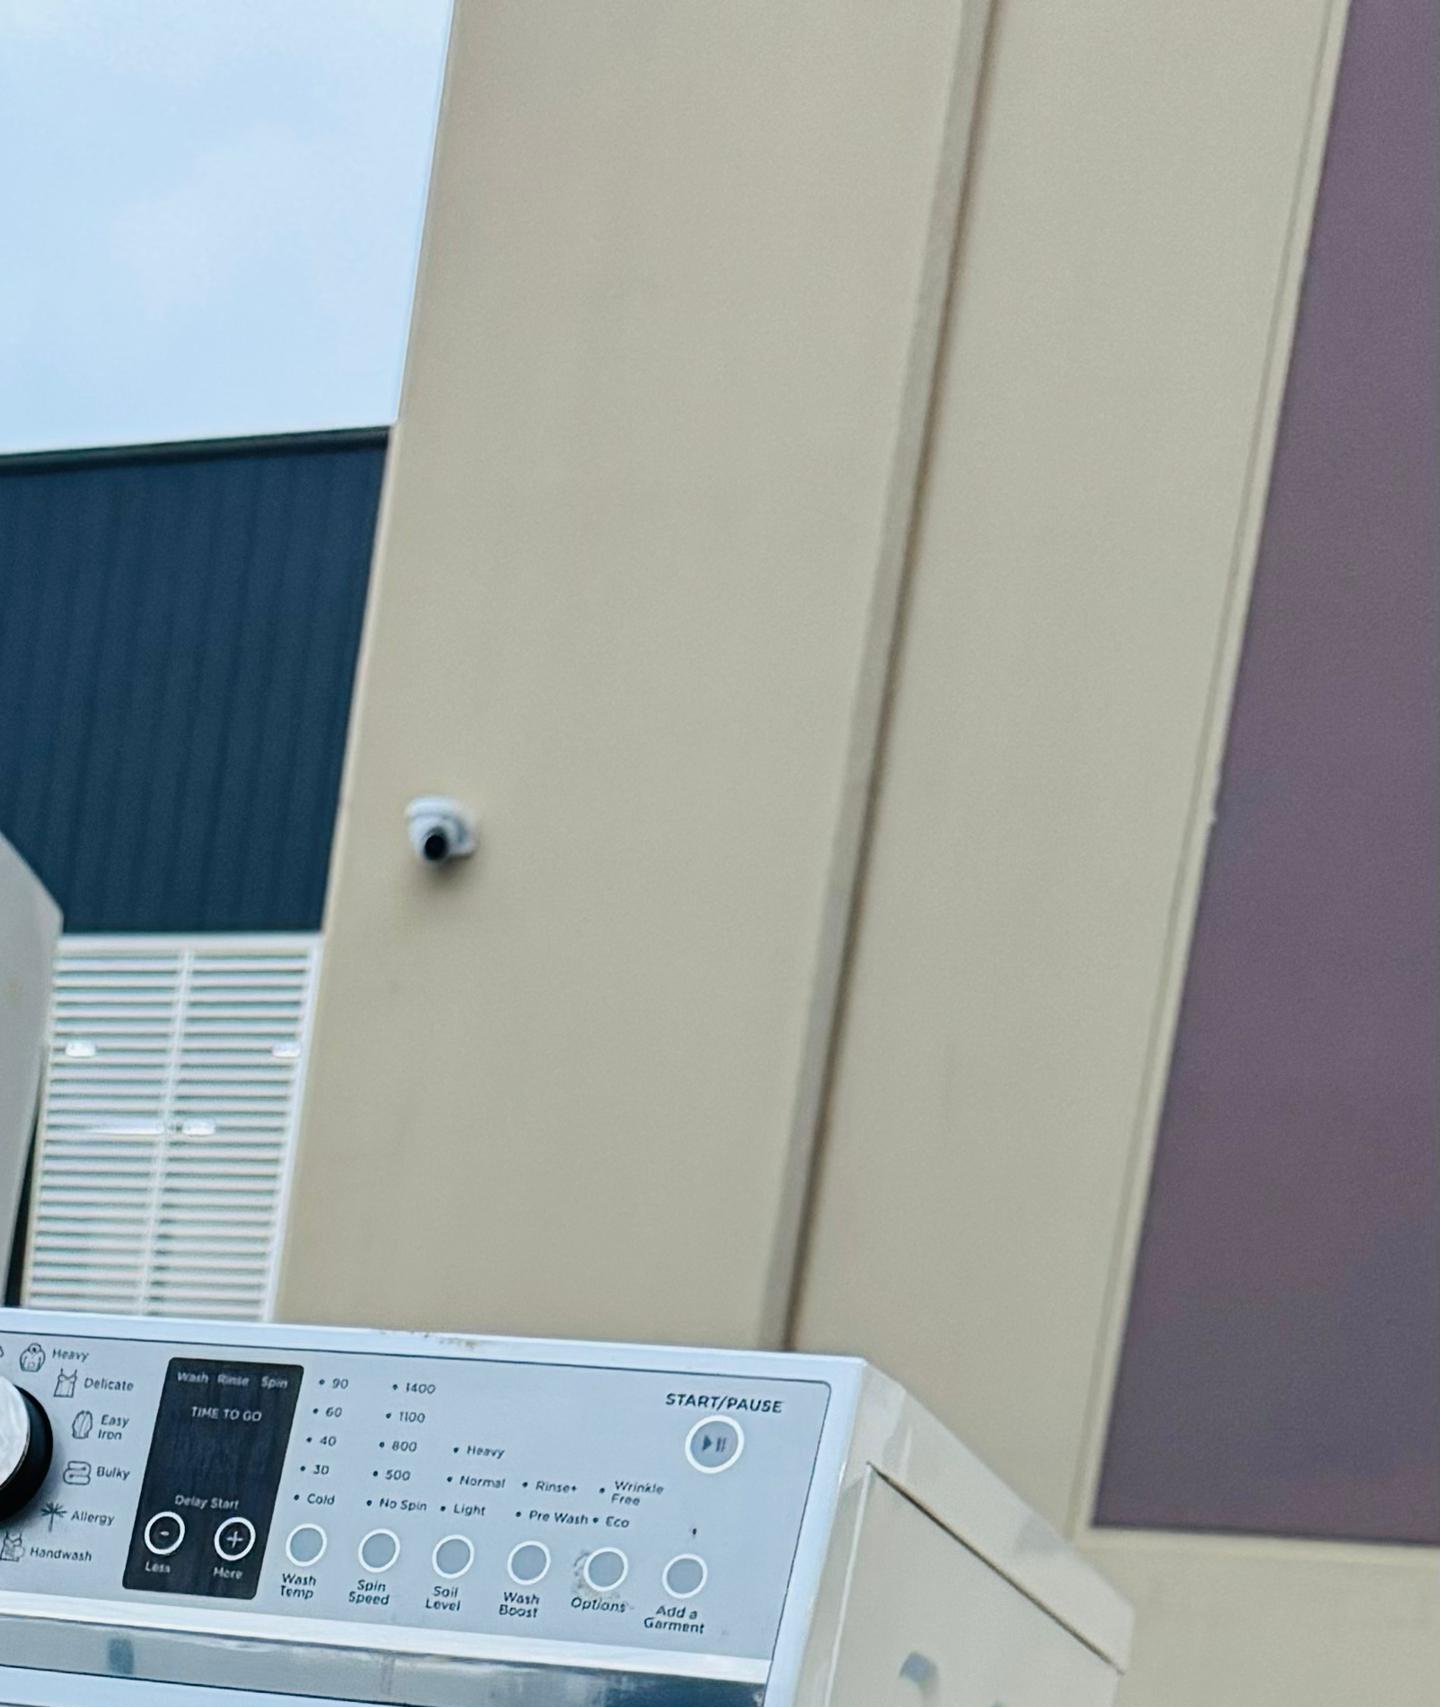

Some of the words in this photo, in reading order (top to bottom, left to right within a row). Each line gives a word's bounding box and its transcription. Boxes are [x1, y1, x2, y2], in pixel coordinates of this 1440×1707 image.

[52, 1348, 90, 1363] Heavy
[84, 1377, 134, 1392] Delicate
[177, 1371, 209, 1384] Wash
[217, 1374, 251, 1387] Rinse
[261, 1375, 289, 1390] Spin
[332, 1378, 350, 1390] 90
[405, 1382, 436, 1395] 1400
[665, 1392, 784, 1414] START/PAUSE
[191, 1406, 220, 1420] TIME
[223, 1409, 240, 1421] TO
[243, 1410, 263, 1422] GO
[325, 1407, 343, 1418] 60
[399, 1411, 426, 1424] 1100
[101, 1414, 130, 1428] Easy
[97, 1429, 123, 1441] Iron
[319, 1435, 337, 1447] 40
[392, 1440, 418, 1452] 800
[466, 1446, 505, 1460] Heavy
[96, 1466, 131, 1482] Bulky
[313, 1464, 330, 1476] 30
[385, 1470, 411, 1482] 500
[459, 1475, 506, 1489] Normal
[614, 1480, 665, 1495] Wrinkle
[175, 1494, 208, 1510] Delay
[210, 1497, 240, 1511] Start
[307, 1493, 336, 1506] Cold
[379, 1498, 397, 1510] No
[400, 1499, 428, 1513] Spin
[611, 1494, 641, 1507] Free
[453, 1504, 487, 1517] Light
[71, 1511, 116, 1527] Allergy
[529, 1510, 550, 1522] Pre
[554, 1512, 589, 1526] Wash
[605, 1516, 630, 1529] Eco
[30, 1547, 93, 1562] Handwash
[145, 1560, 171, 1574] Less
[213, 1566, 243, 1580] More
[282, 1573, 317, 1587] Wash
[357, 1578, 386, 1593] Spin
[280, 1585, 314, 1600] Temp
[349, 1591, 390, 1606] Speed
[433, 1585, 459, 1599] Soil
[503, 1592, 540, 1606] Wash
[425, 1599, 461, 1612] Level
[498, 1604, 538, 1619] Boost
[570, 1597, 626, 1614] Options
[655, 1606, 686, 1620] Add
[688, 1610, 698, 1620] a
[643, 1616, 705, 1635] Garment
